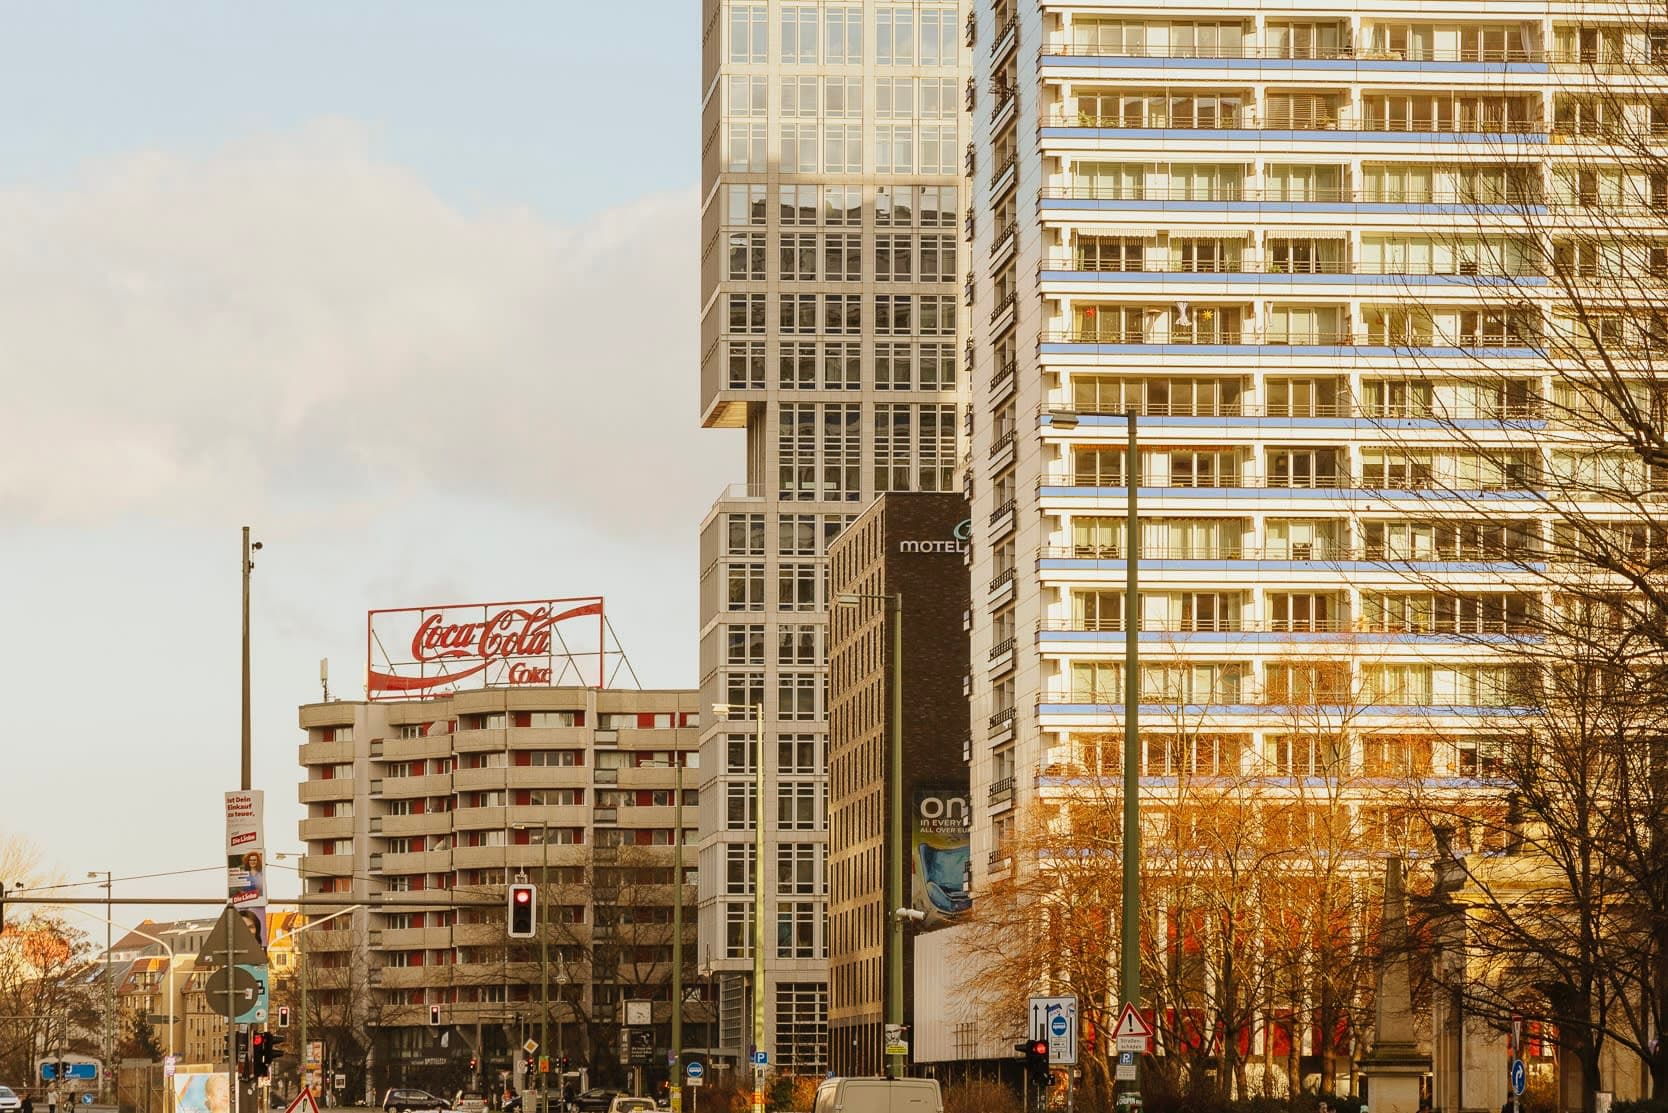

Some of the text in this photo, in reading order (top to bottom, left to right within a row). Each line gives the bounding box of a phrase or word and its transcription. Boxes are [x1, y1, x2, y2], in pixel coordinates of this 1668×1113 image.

[412, 607, 553, 662] Coca-Cola
[509, 662, 553, 684] Coke
[932, 819, 962, 827] EVERY
[758, 1053, 765, 1063] P
